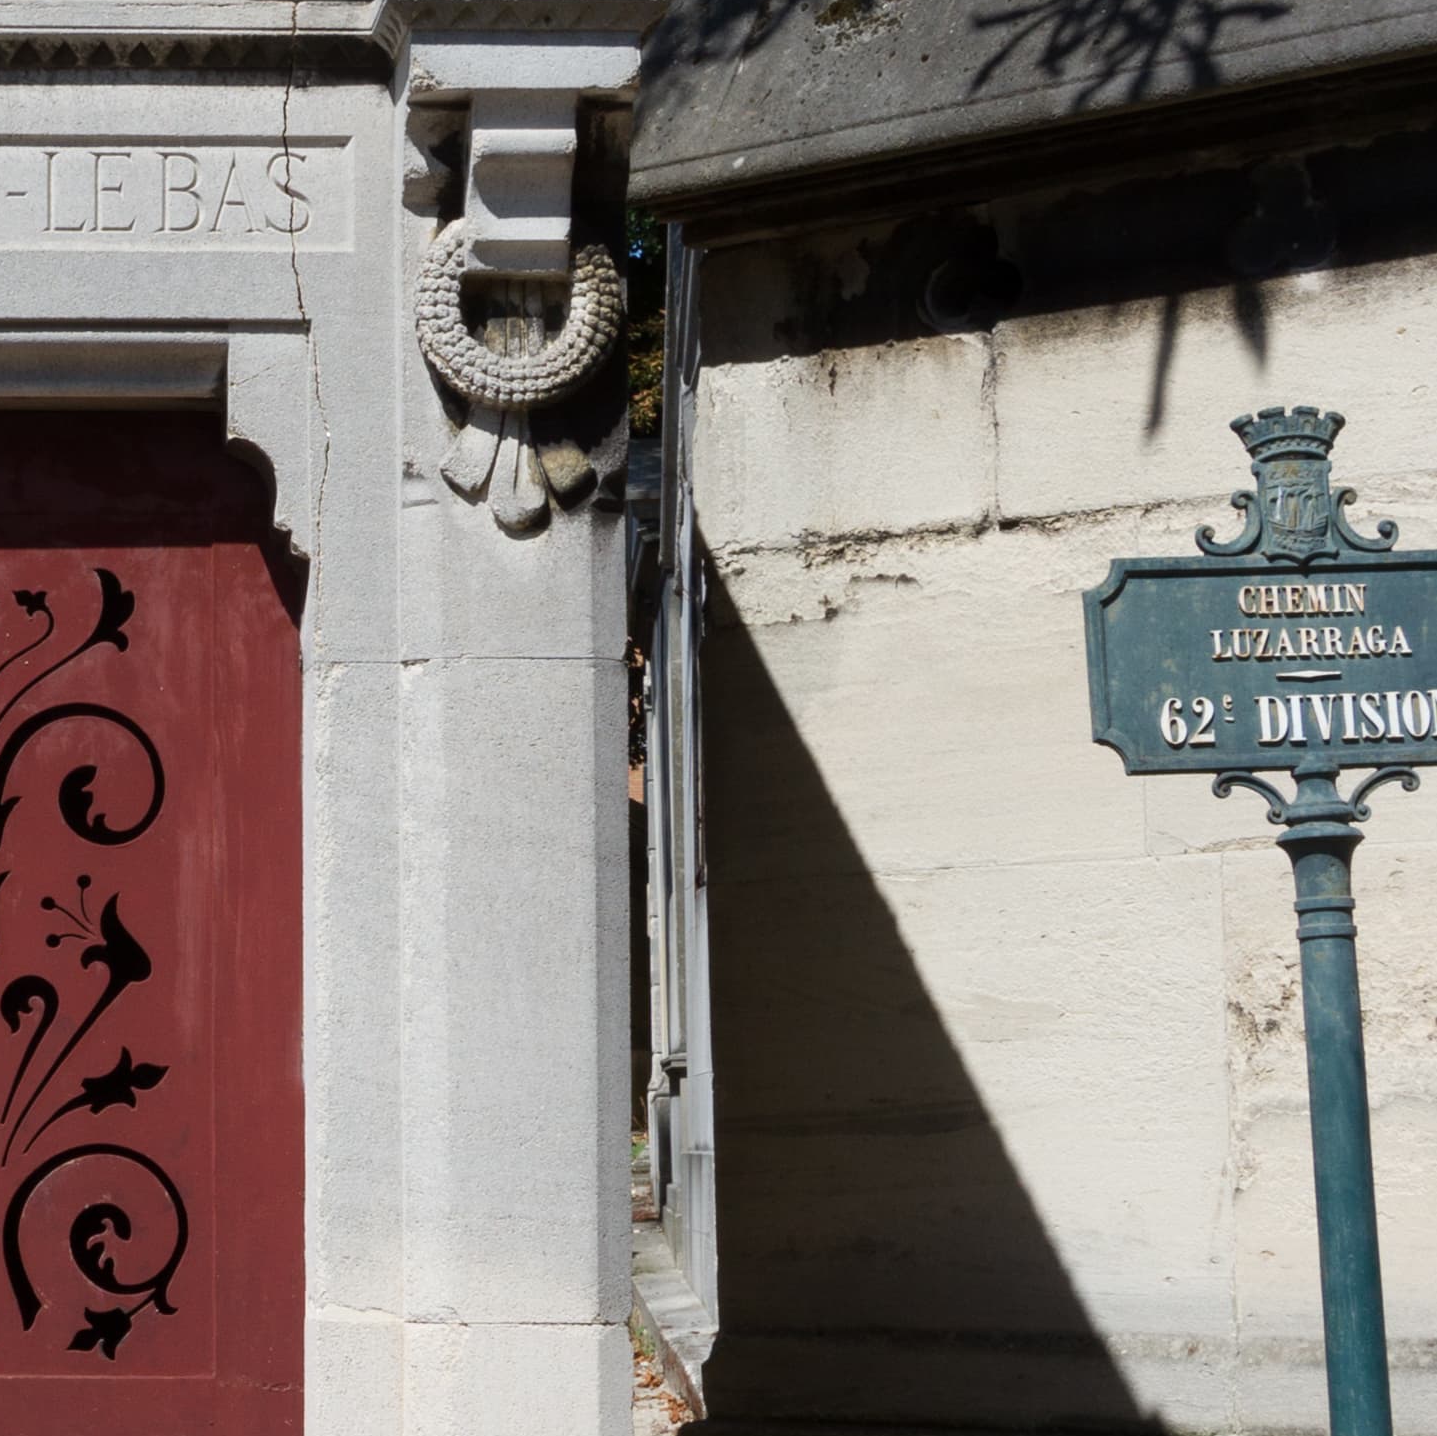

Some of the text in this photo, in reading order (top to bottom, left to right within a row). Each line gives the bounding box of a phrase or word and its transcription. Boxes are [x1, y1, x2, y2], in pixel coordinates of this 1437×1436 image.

[1238, 583, 1368, 616] CHEMIN
[1210, 625, 1413, 659] LUZARRAGA
[1254, 689, 1437, 745] DIVISIO
